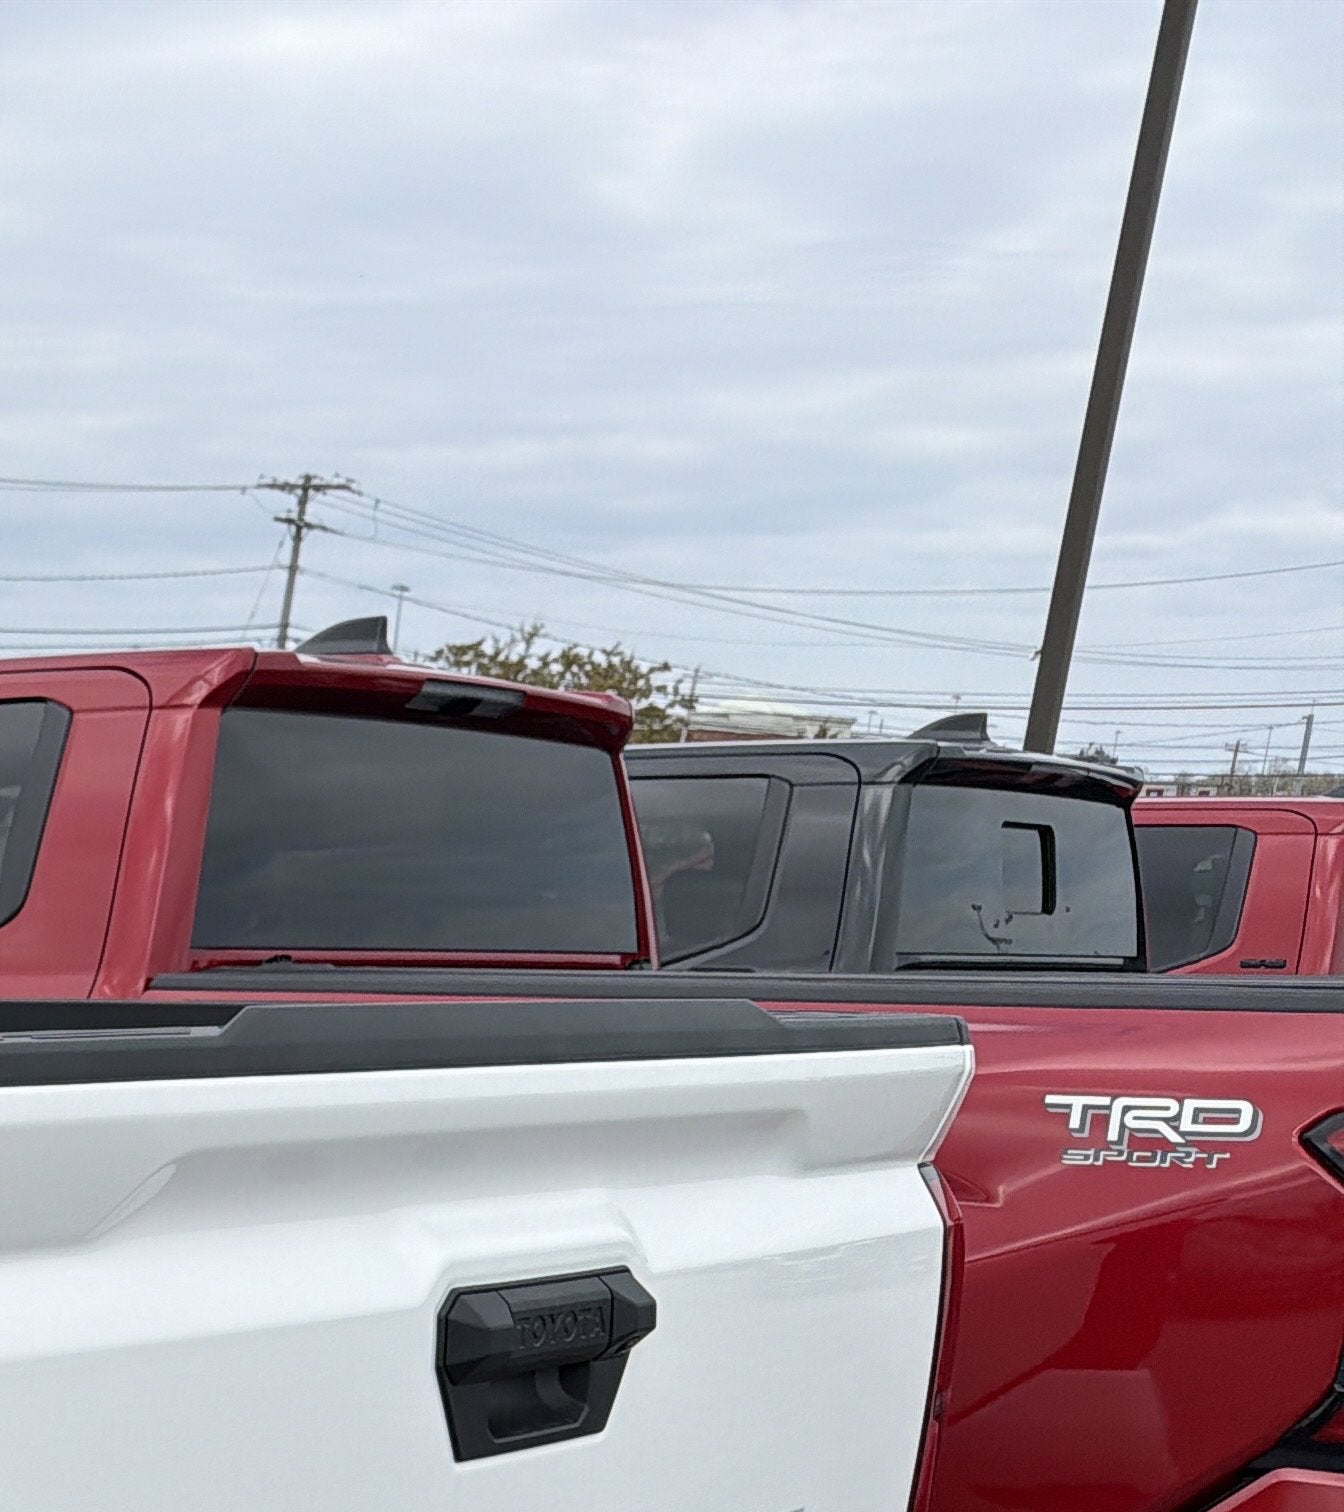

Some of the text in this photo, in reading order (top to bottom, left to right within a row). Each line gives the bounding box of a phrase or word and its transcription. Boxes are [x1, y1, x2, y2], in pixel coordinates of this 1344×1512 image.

[1044, 1094, 1264, 1150] TRD
[1061, 1148, 1231, 1169] SPORT
[515, 1305, 606, 1350] TOYOTA
